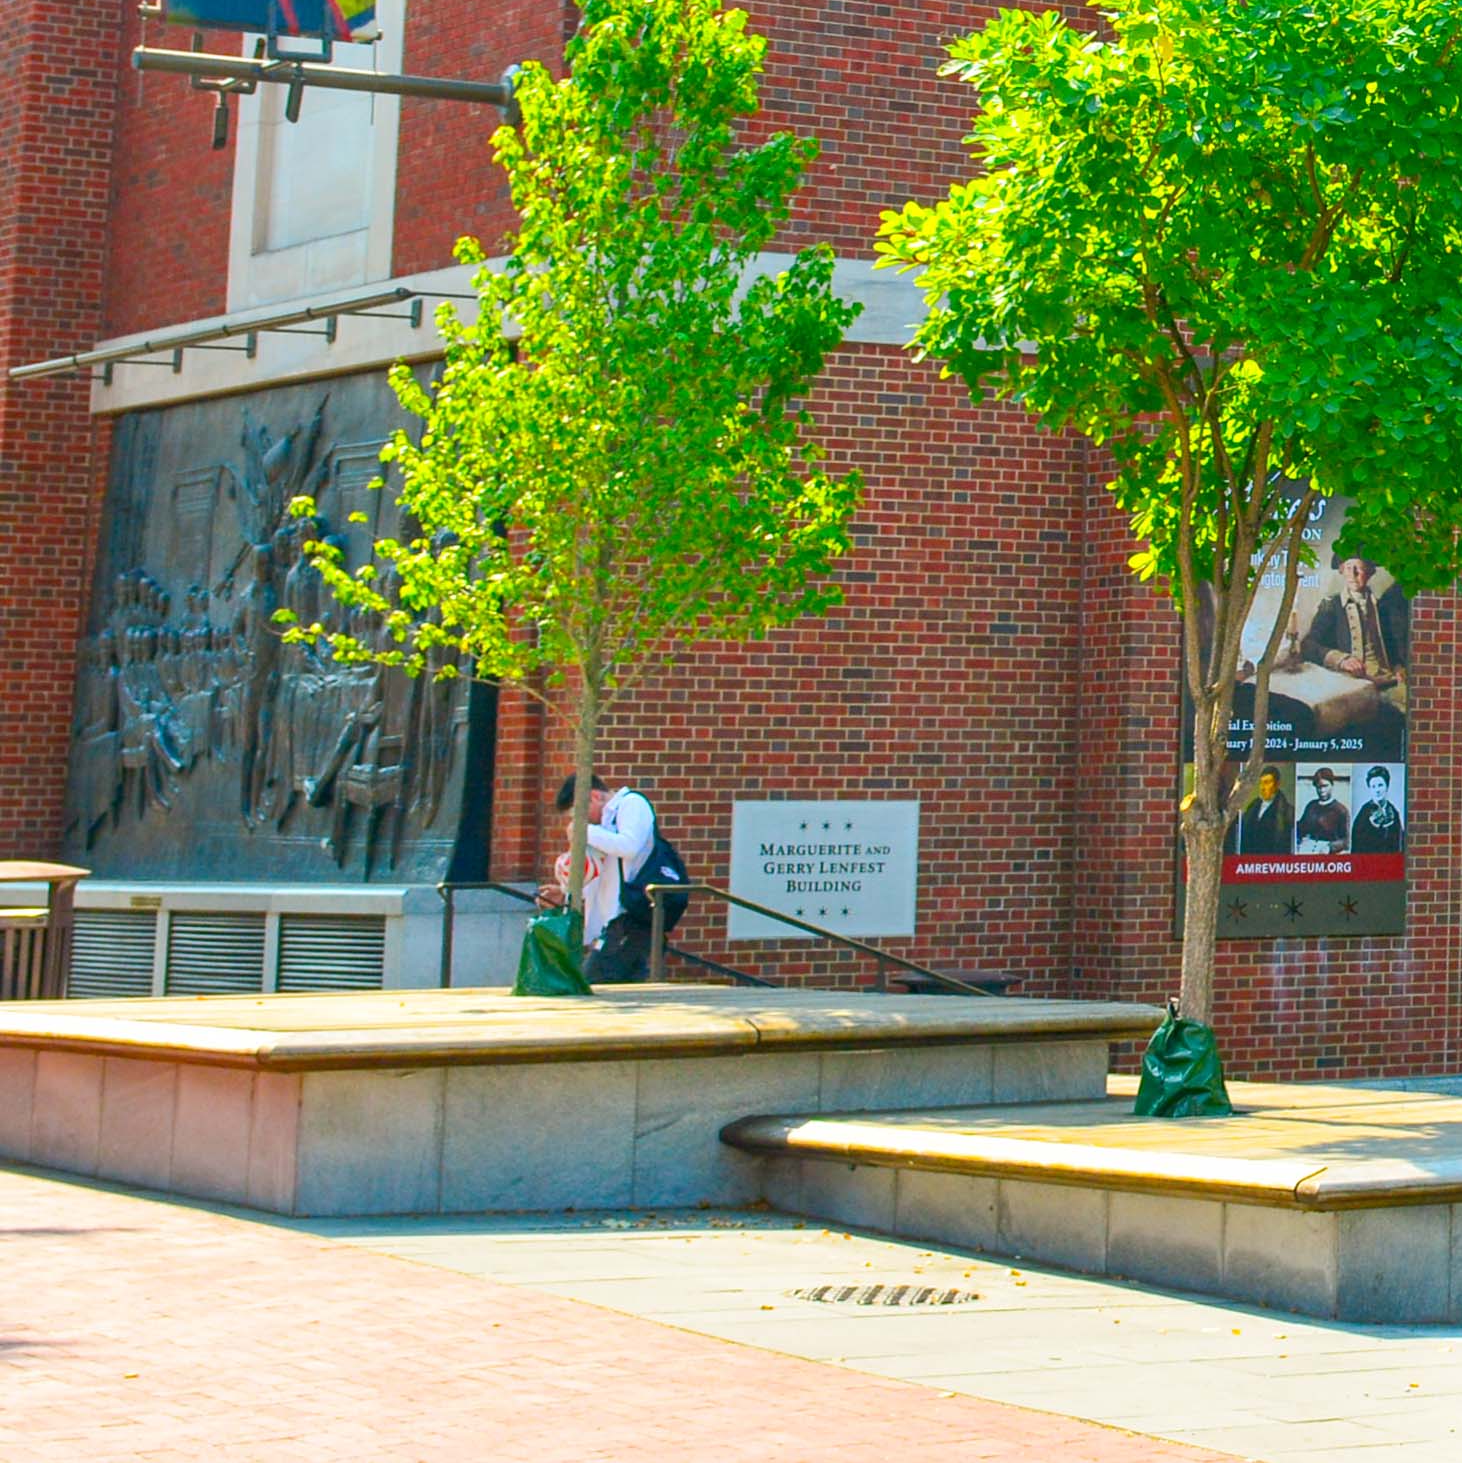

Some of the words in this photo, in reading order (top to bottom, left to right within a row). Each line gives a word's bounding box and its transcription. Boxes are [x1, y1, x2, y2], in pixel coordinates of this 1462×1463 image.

[1293, 738, 1328, 752] January
[1341, 738, 1363, 749] 2025
[759, 843, 862, 857] MARGUERITE
[763, 861, 815, 875] GERRY
[819, 861, 886, 874] LENFEST
[1235, 860, 1352, 875] AMREVMUSEUM.ORG
[786, 879, 862, 893] BUILDING
